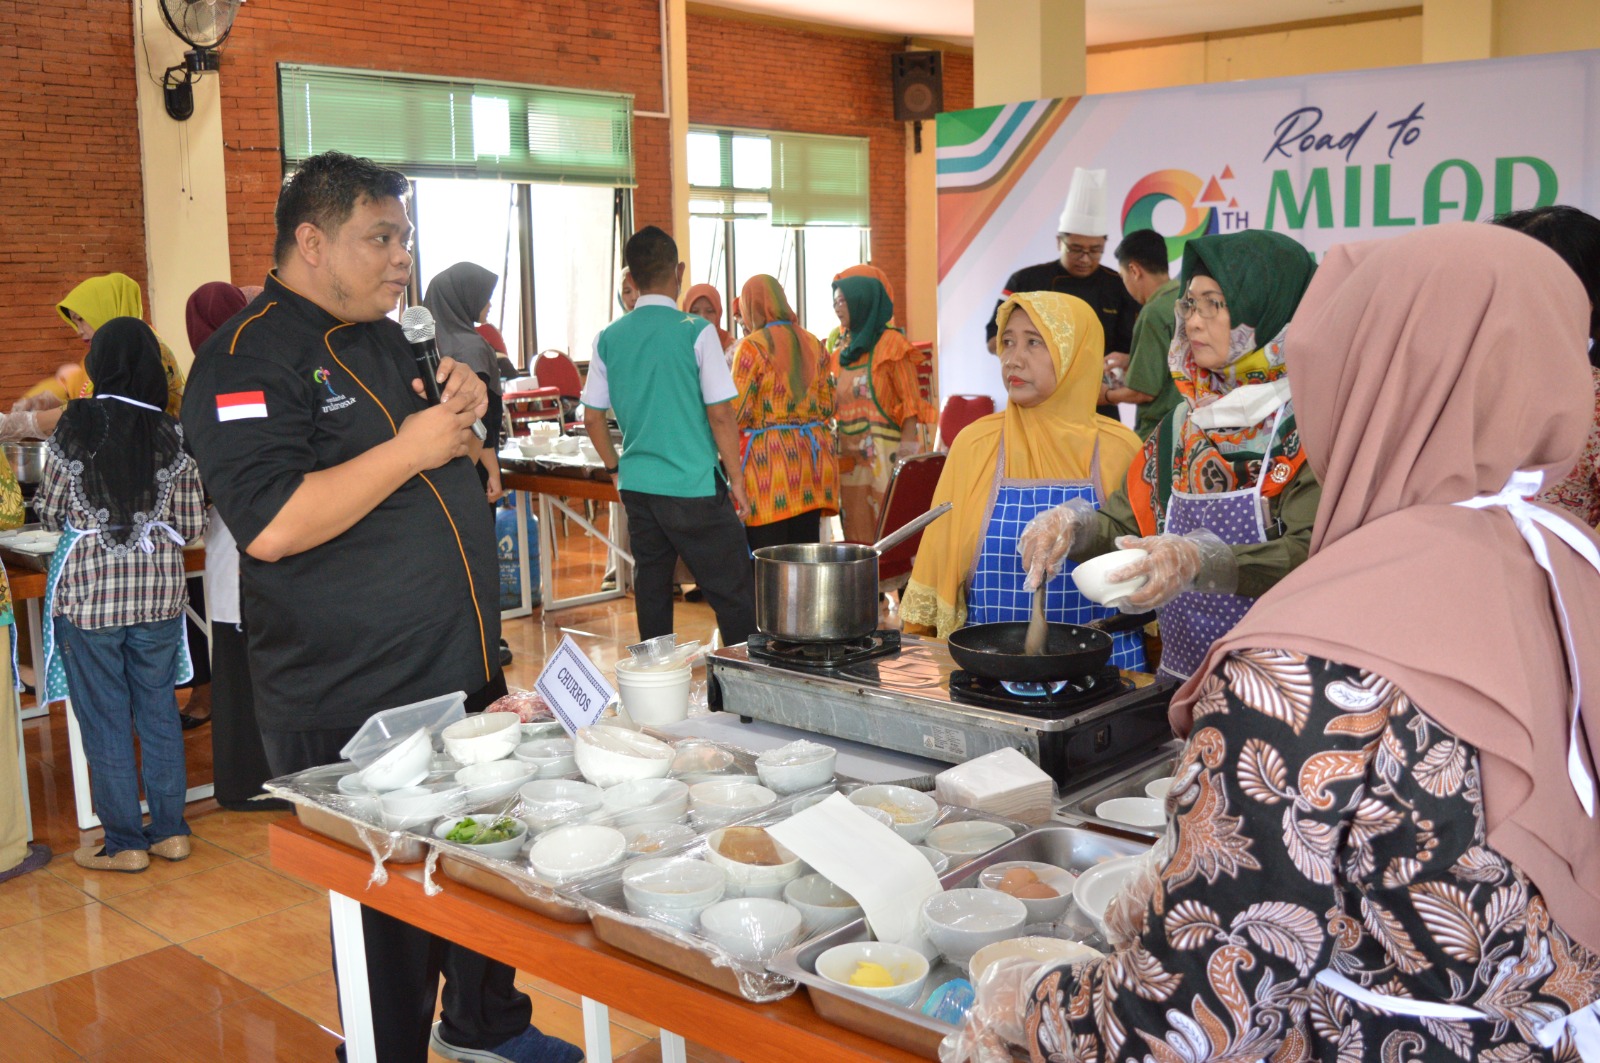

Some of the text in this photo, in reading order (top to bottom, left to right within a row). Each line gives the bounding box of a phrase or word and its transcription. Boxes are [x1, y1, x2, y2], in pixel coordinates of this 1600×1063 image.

[1263, 102, 1425, 162] Road to
[1264, 156, 1559, 230] MILAD
[557, 667, 592, 712] CHURROS
